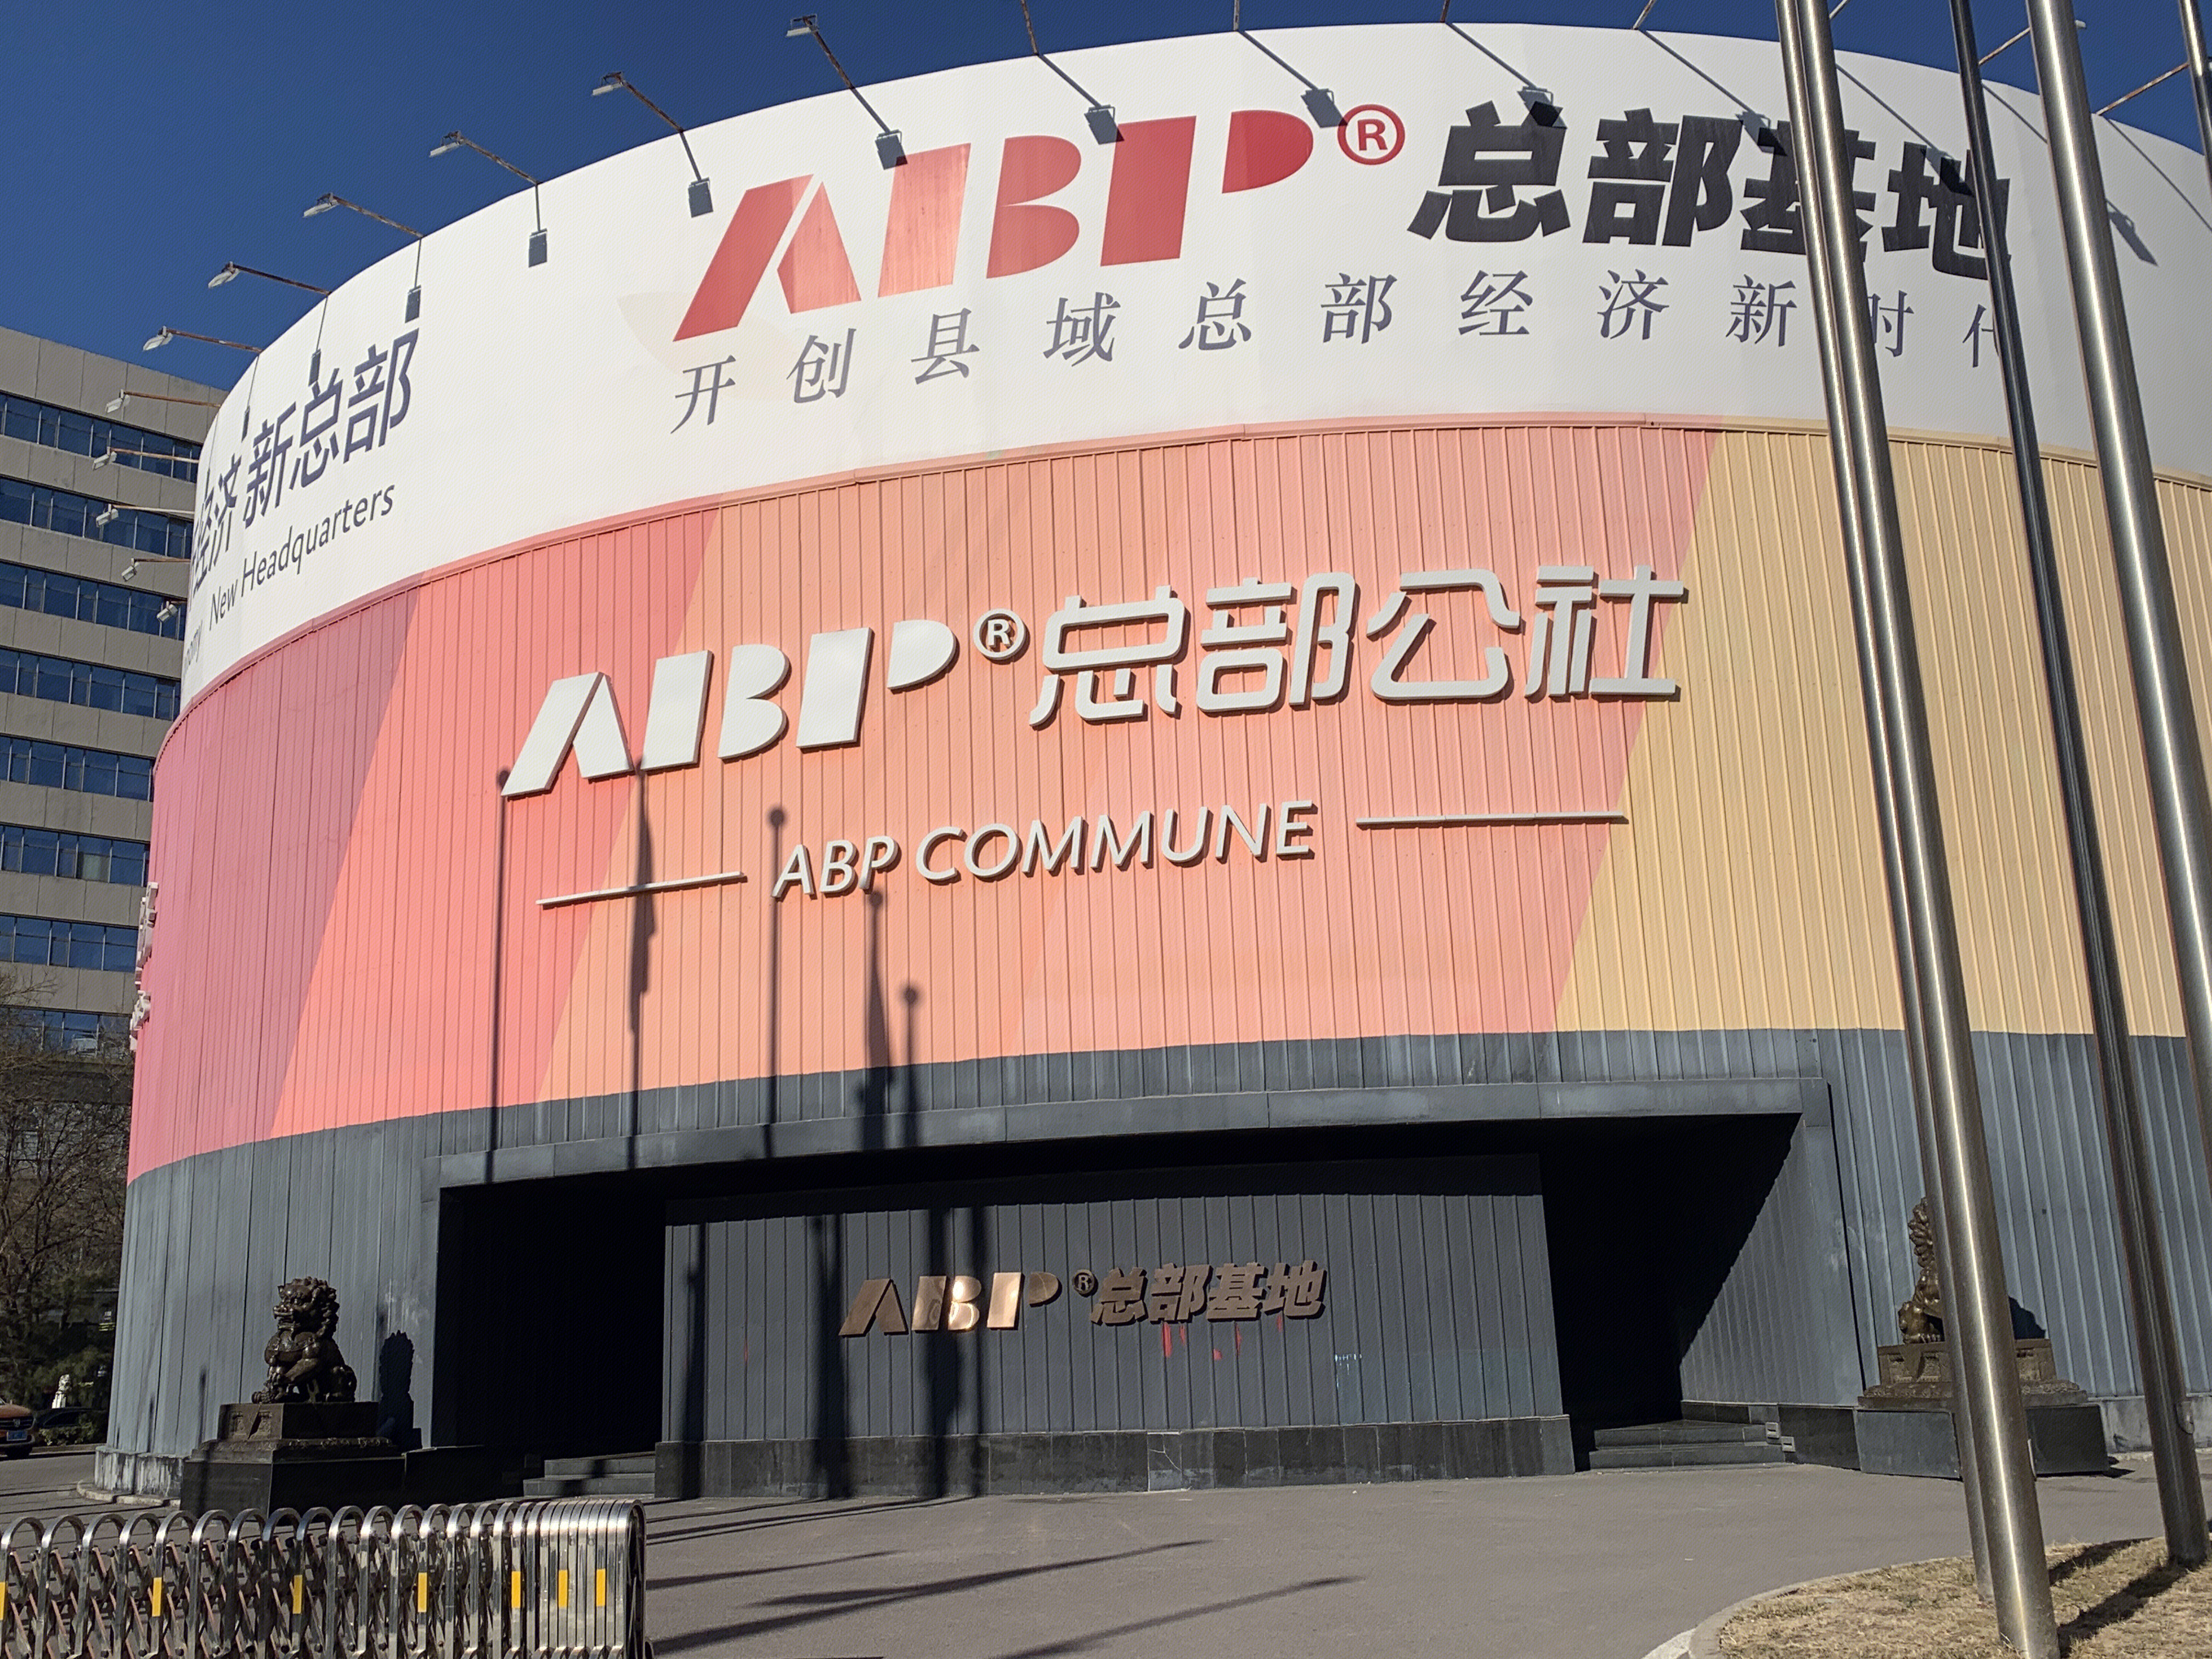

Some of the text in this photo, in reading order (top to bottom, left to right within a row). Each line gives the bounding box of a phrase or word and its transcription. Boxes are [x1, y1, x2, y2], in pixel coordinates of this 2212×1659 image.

[673, 110, 1314, 342] ABP
[210, 579, 238, 631] New
[241, 484, 395, 597] Headquarters
[501, 619, 957, 798] ABP
[1029, 565, 1685, 727] 总部公社
[771, 799, 1314, 900] ABP COMMUNE
[839, 1271, 1059, 1336] ABP
[1090, 1260, 1326, 1325] 总部基地
